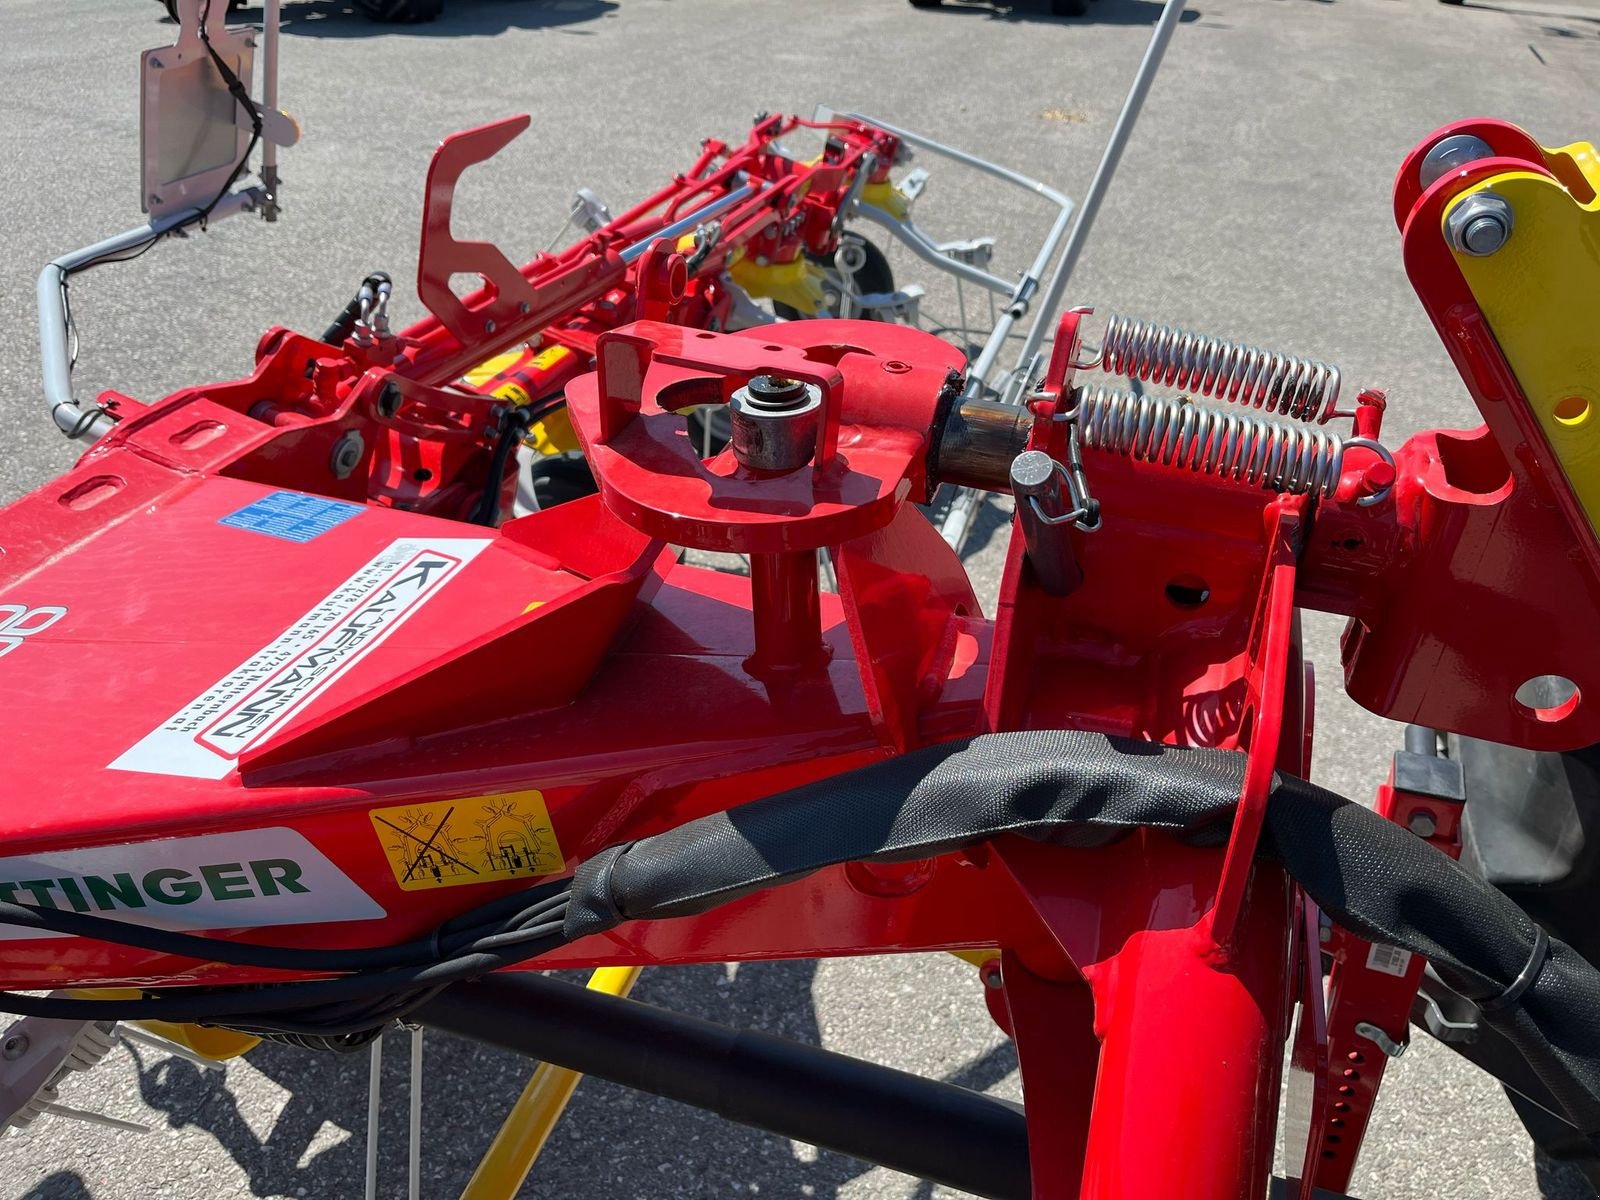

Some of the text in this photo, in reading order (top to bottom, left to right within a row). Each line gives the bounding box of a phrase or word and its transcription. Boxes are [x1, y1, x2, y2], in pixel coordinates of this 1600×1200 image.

[345, 579, 379, 603] 07278
[302, 624, 327, 640] 165
[323, 611, 341, 621] 20
[164, 560, 385, 732] www.kaufmann-traktoren.at
[211, 560, 449, 737] KAUFMANN
[259, 651, 292, 673] 4723
[235, 608, 397, 738] LANDMASCHINEN
[179, 674, 263, 733] Natternbach
